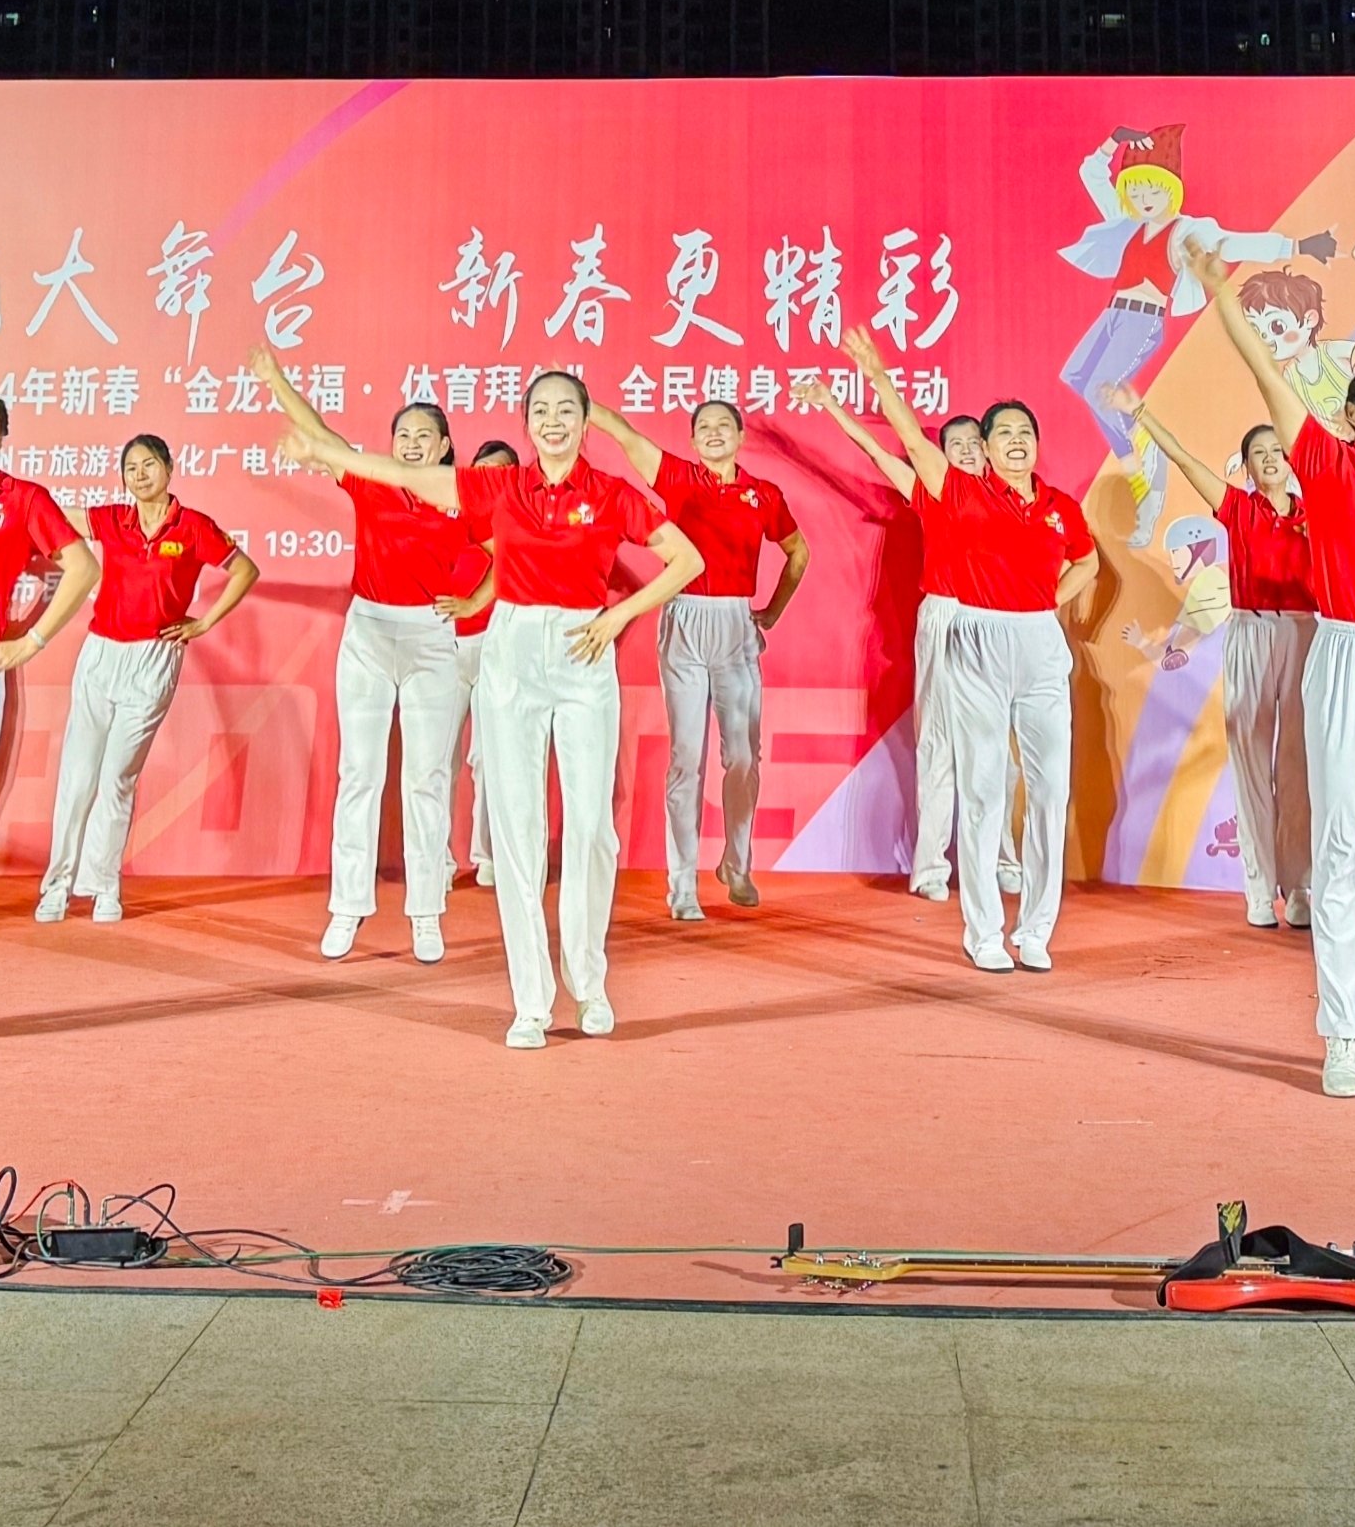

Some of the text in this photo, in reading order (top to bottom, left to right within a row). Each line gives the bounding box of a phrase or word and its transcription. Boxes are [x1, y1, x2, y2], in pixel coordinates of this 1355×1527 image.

[437, 222, 960, 354] 新春更精彩
